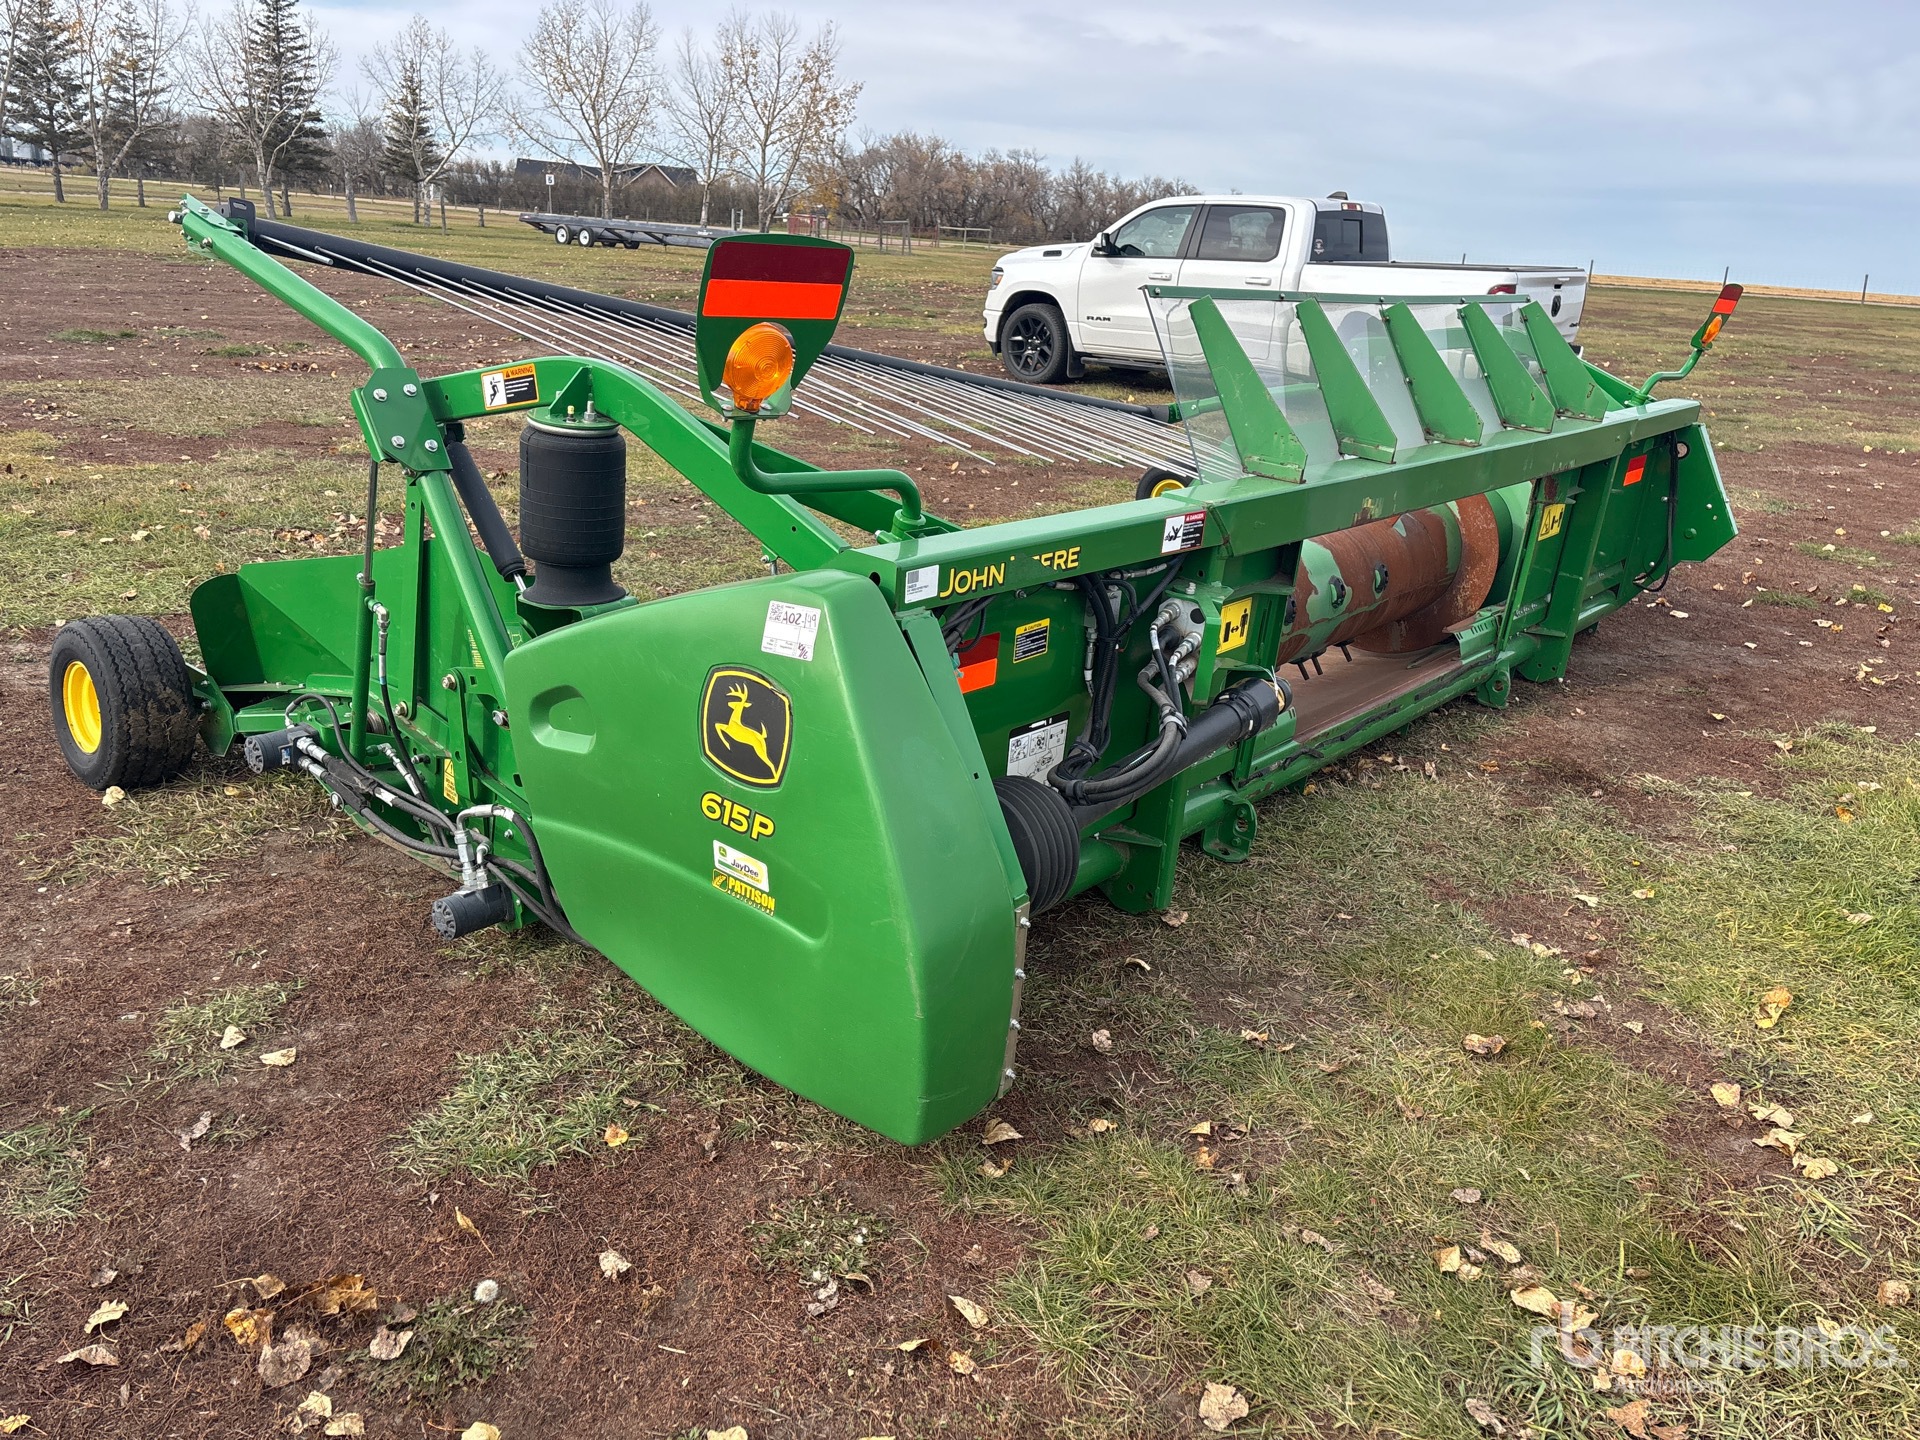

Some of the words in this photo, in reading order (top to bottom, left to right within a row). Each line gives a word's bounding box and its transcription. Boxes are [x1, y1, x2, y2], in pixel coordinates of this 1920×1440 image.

[510, 366, 533, 376] WARNING
[1189, 513, 1204, 521] DANGER
[939, 562, 1006, 598] JOHN
[1028, 622, 1043, 631] CAUTION
[731, 859, 759, 877] JayDee
[728, 877, 776, 910] PATTISON
